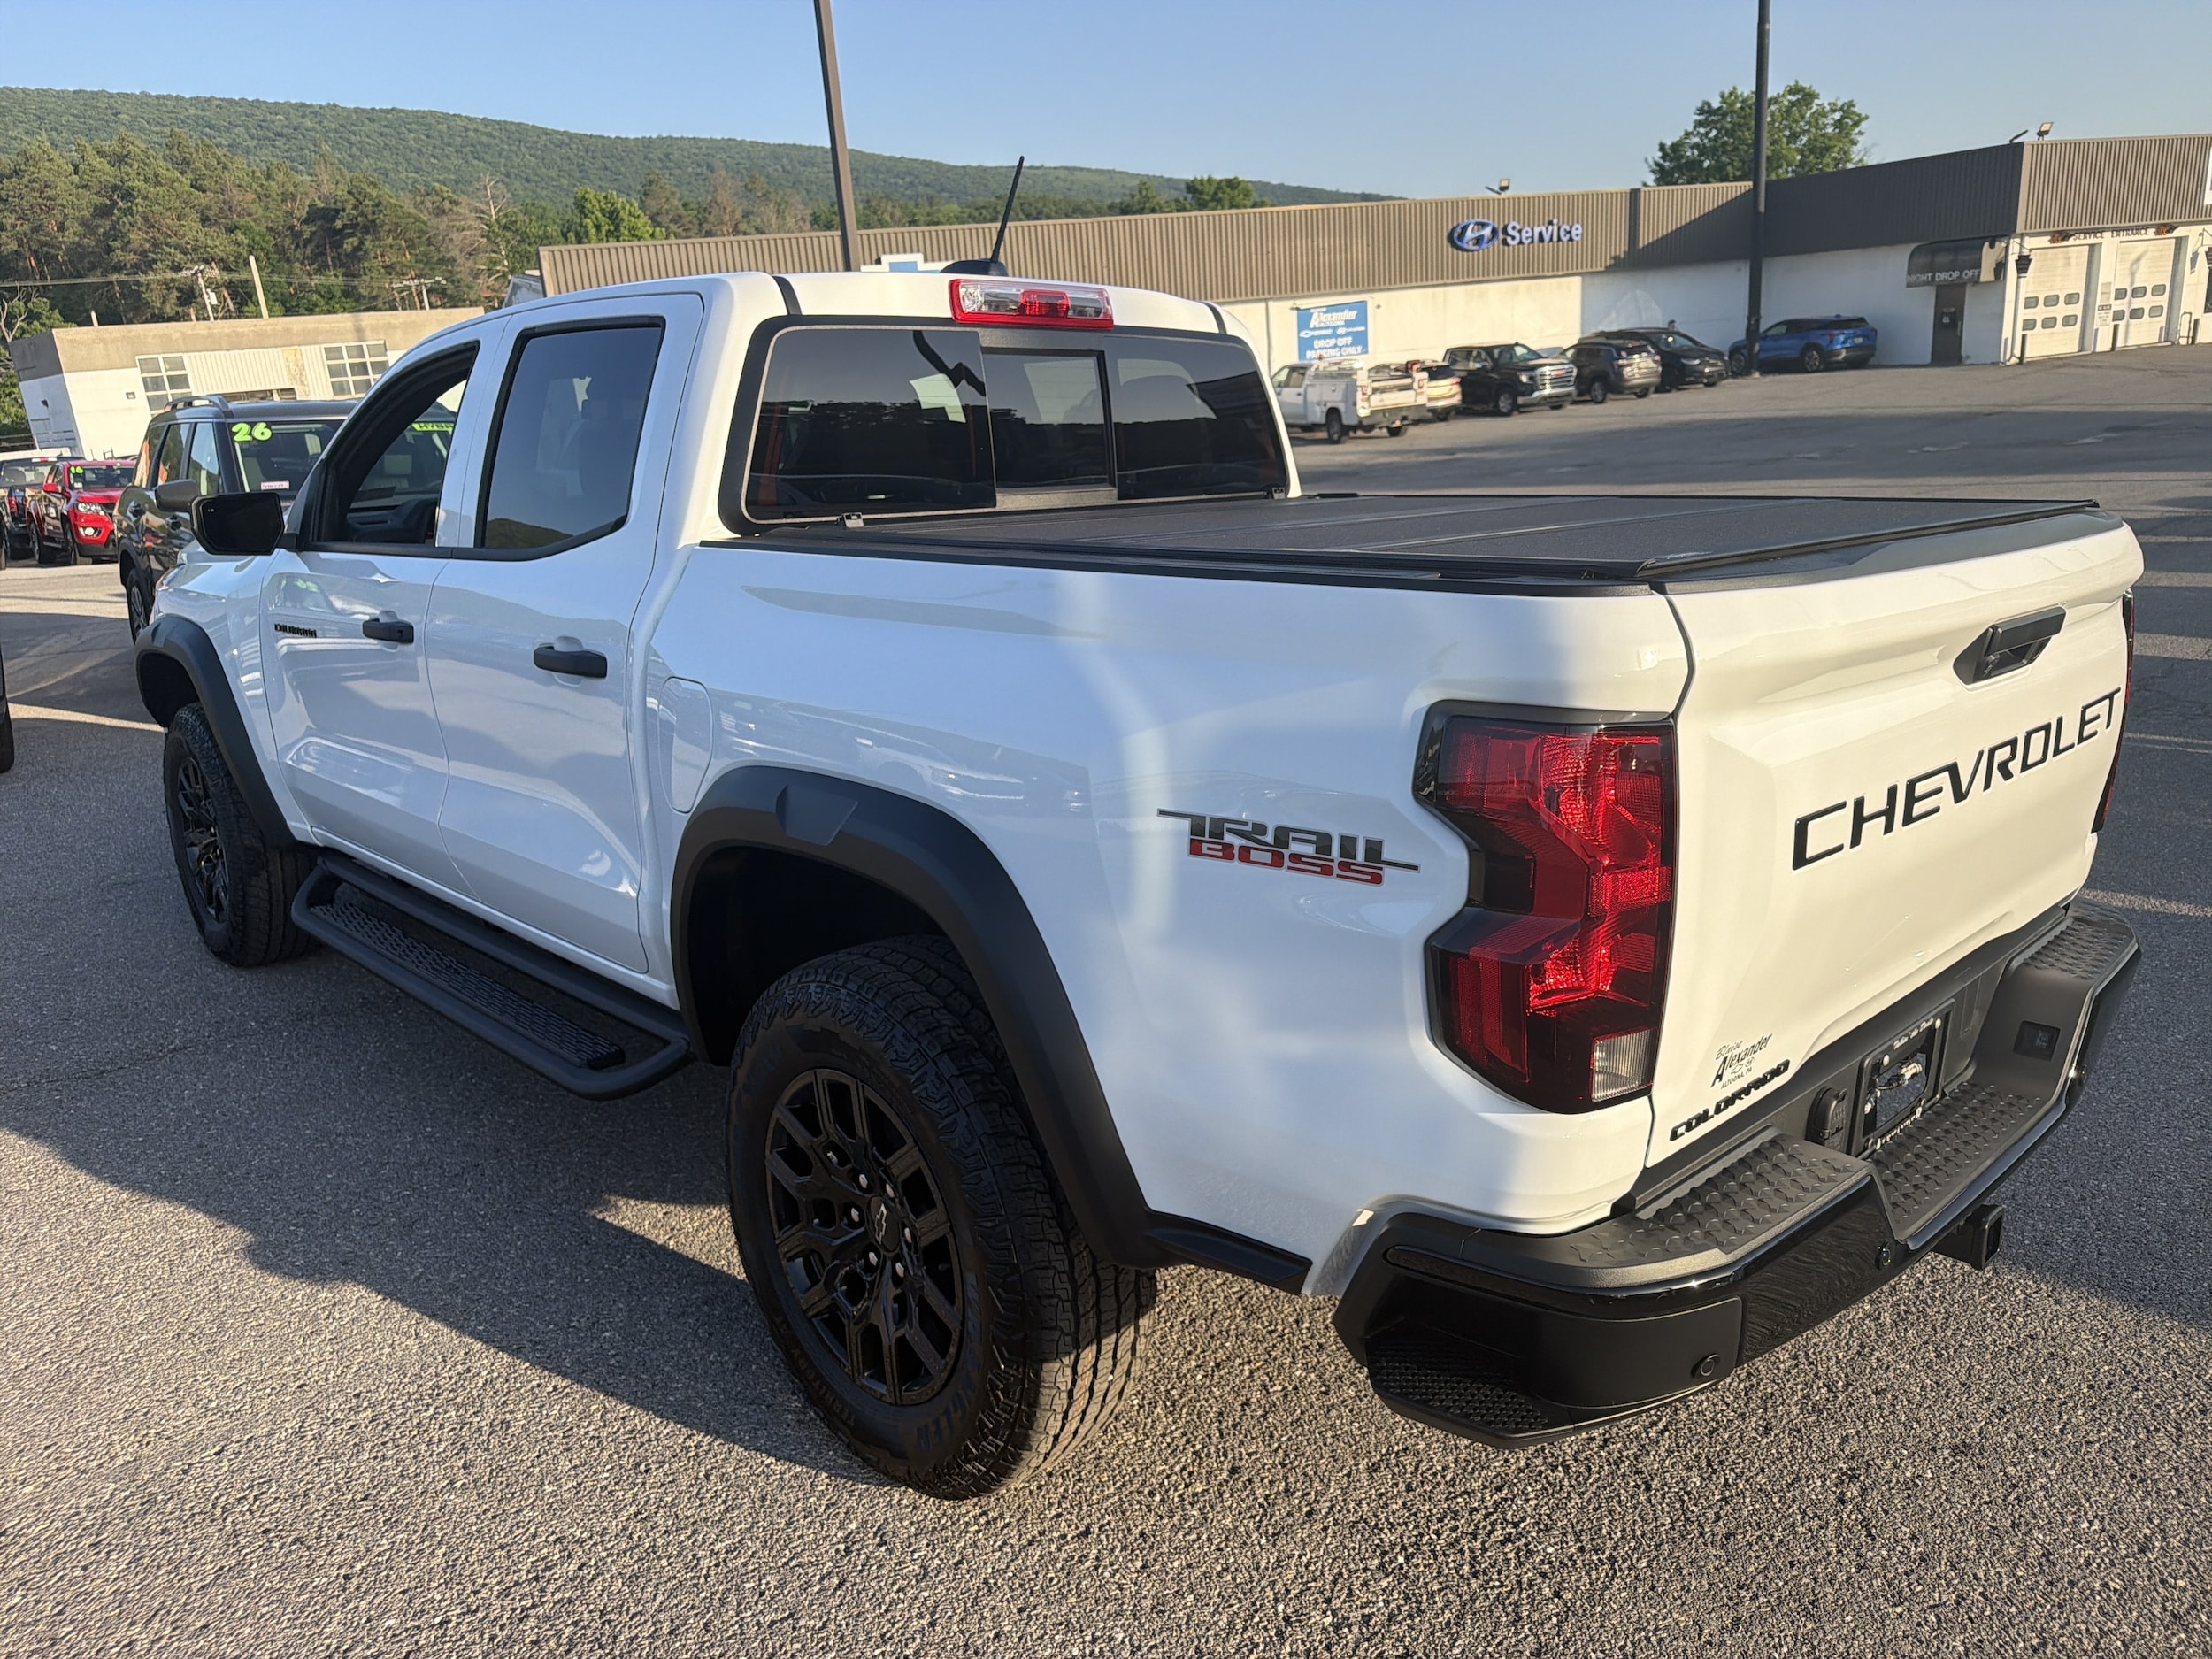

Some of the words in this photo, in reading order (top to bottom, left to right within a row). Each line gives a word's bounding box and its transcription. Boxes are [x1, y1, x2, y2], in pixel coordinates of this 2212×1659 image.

[1506, 218, 1582, 245] Service
[2073, 231, 2105, 241] SERVICE
[2111, 227, 2149, 238] ENTRANCE
[1907, 273, 1932, 283] NIGHT
[1935, 271, 1960, 281] DROP
[1962, 268, 1980, 279] OFF
[232, 422, 272, 441] 26
[1792, 687, 2122, 871] CHEVROLET
[1156, 808, 1420, 873] TRAIL
[1187, 837, 1385, 887] BOSS
[1710, 1033, 1773, 1088] Alexander
[1669, 1058, 1791, 1141] COLORADO
